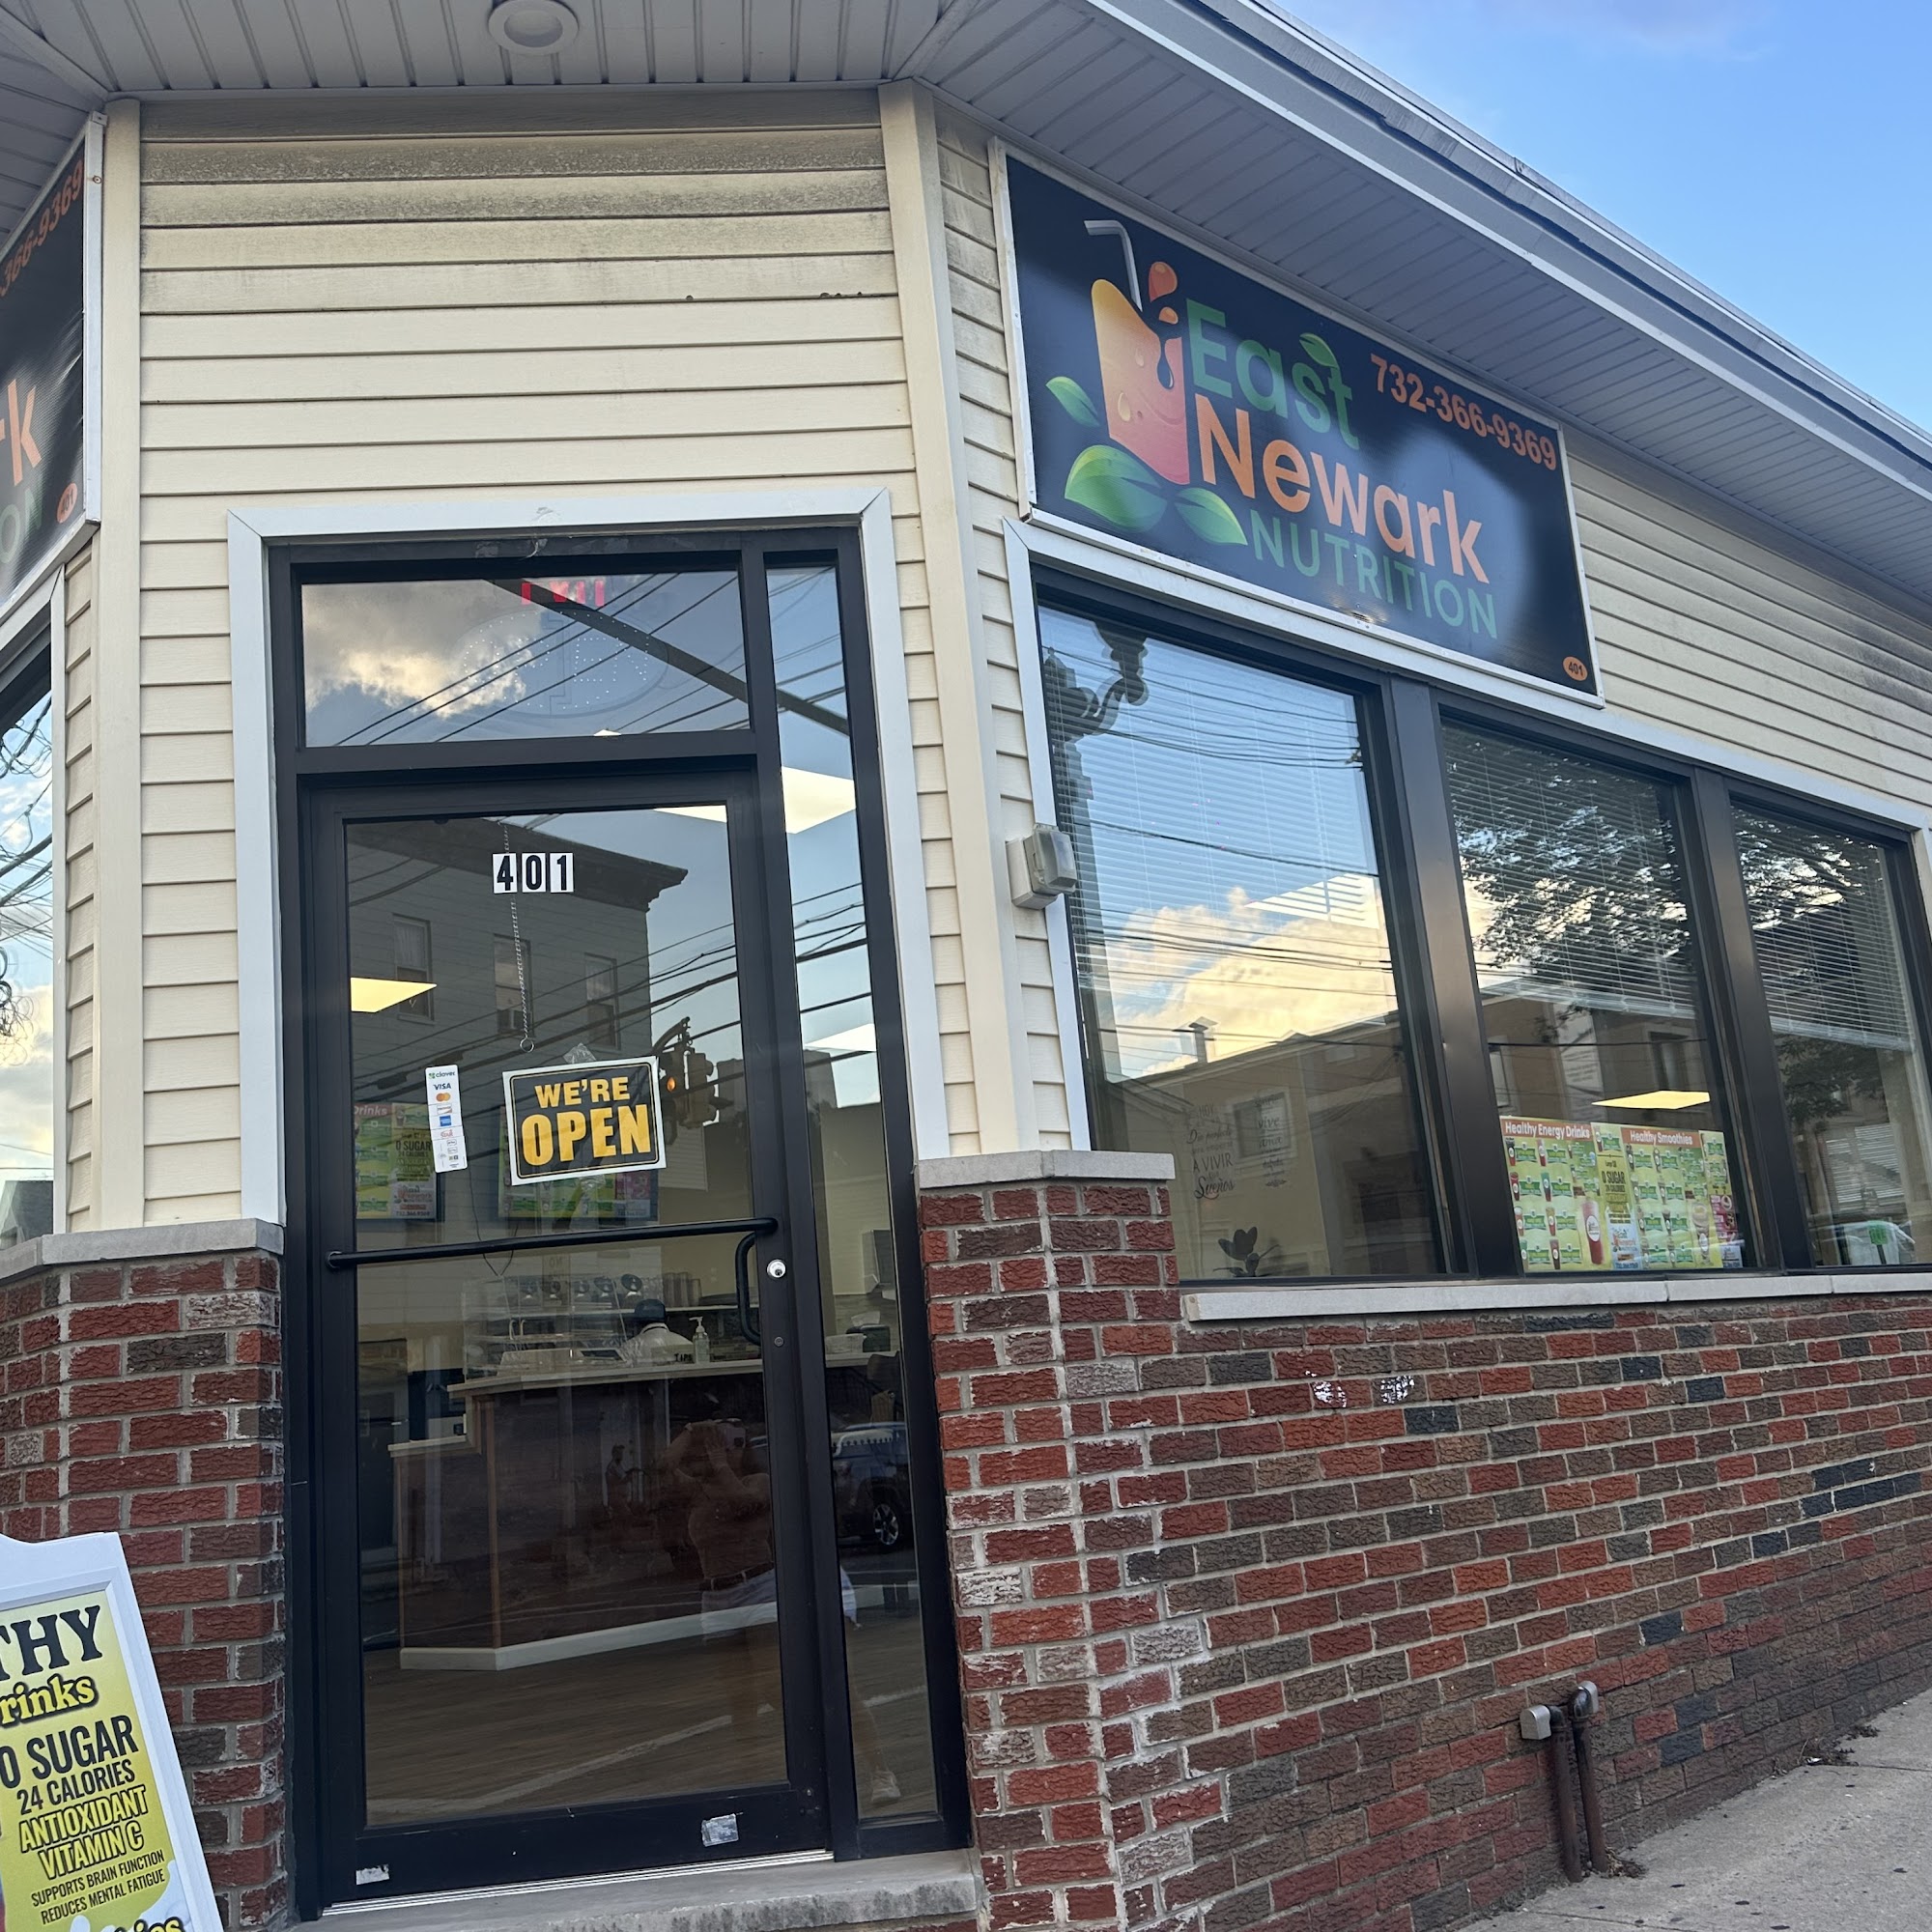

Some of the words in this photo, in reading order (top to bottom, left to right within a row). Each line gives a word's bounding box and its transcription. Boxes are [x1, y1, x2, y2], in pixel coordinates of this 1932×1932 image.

[1185, 298, 1359, 450] East
[0, 379, 42, 487] k
[1370, 354, 1557, 471] 732-366-9369
[60, 487, 75, 515] 401
[1196, 394, 1491, 584] Newark
[1249, 509, 1498, 639] NUTRITION
[1567, 660, 1584, 677] 401
[497, 854, 568, 892] 401
[433, 1082, 452, 1091] VISA
[534, 1076, 631, 1109] WE'RE
[403, 1140, 432, 1152] SUGAR
[521, 1103, 652, 1167] OPEN
[1505, 1122, 1537, 1138] Healthy
[1538, 1123, 1565, 1140] Energy
[1566, 1125, 1590, 1138] Drinks
[1630, 1129, 1657, 1147] Healthy
[1658, 1131, 1693, 1146] Smoothies
[1202, 1151, 1234, 1172] VIVIR
[1606, 1170, 1626, 1184] SUGAR
[26, 1715, 140, 1781] SUGAR
[16, 1789, 43, 1816] 24
[47, 1759, 136, 1805] CALORIES
[18, 1784, 150, 1853] ANTIOXIDANT
[31, 1878, 86, 1908] SUPPORTS
[86, 1864, 118, 1890] BRAIN
[118, 1849, 165, 1880] FUNCTION
[38, 1828, 127, 1882] VITAMIN
[122, 1820, 145, 1853] C
[41, 1896, 88, 1925] REDUCES
[88, 1882, 128, 1910] MENTAL
[127, 1868, 166, 1896] FATIGUE
